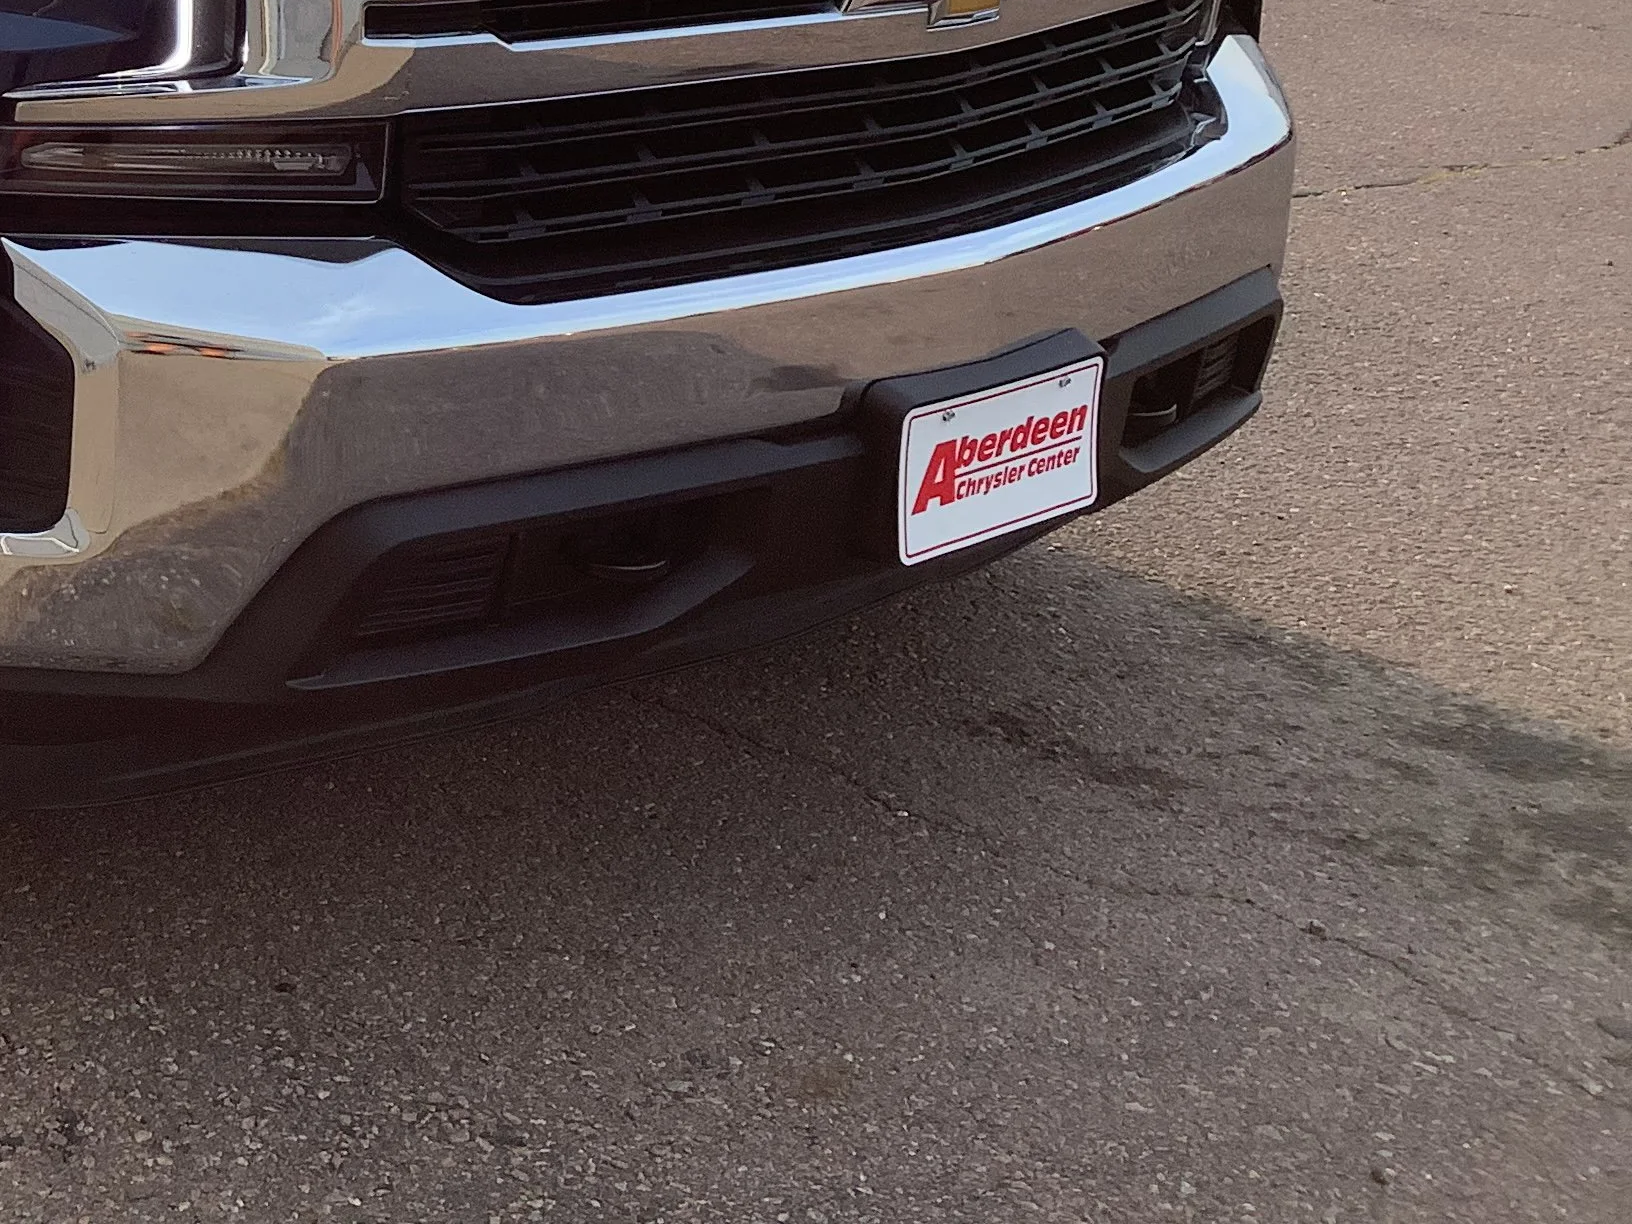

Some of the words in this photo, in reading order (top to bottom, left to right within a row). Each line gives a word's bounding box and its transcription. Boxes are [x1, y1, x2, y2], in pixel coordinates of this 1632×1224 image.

[911, 404, 1088, 516] Aberdeen
[957, 463, 1025, 500] Chrysler
[1028, 446, 1081, 478] Center
